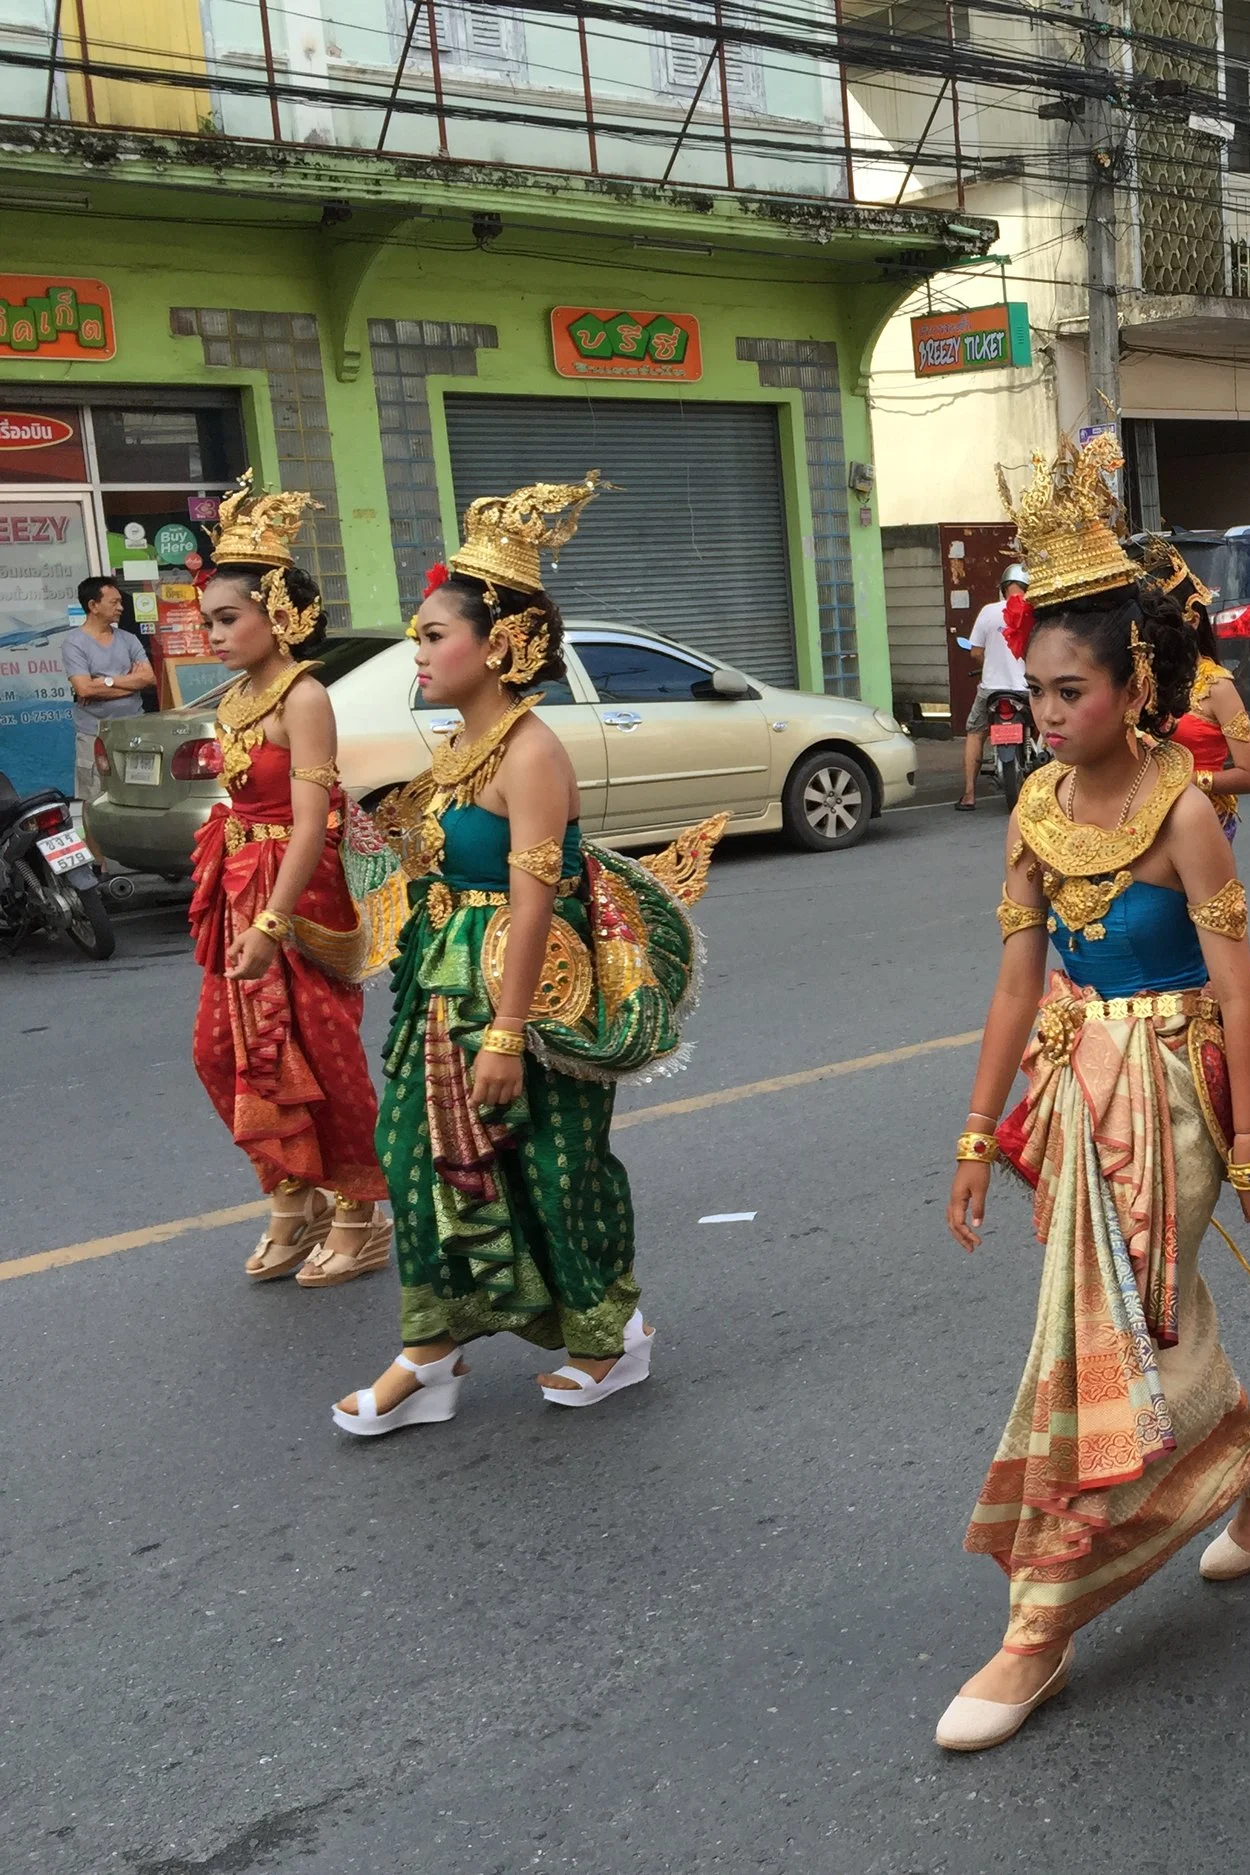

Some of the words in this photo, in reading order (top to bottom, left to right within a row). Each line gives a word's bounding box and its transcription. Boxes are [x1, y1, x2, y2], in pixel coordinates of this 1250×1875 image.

[918, 335, 961, 371] BREEZY
[964, 332, 1005, 361] TICKET
[160, 531, 188, 543] Buy
[160, 541, 194, 554] Here
[28, 660, 63, 674] DAIL
[57, 852, 86, 870] 579
